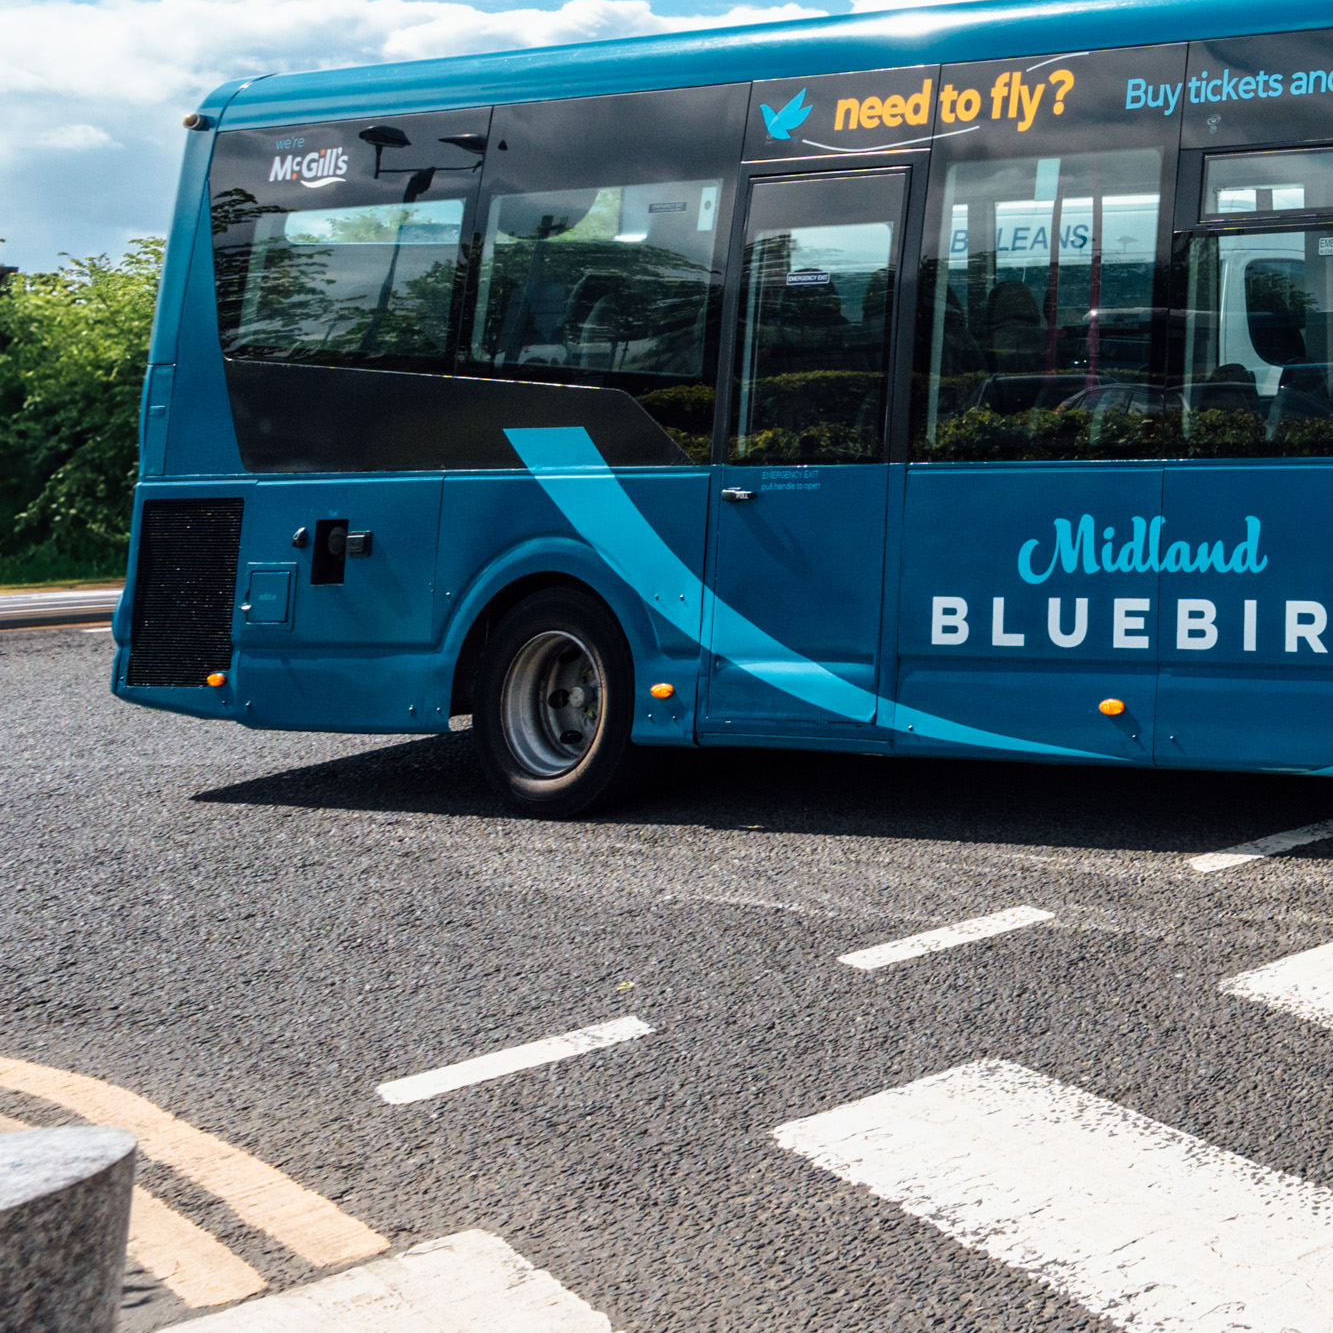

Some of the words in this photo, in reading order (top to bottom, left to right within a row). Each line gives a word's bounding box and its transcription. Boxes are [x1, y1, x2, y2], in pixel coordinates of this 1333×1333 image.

[834, 78, 933, 131] need
[940, 84, 982, 123] to
[990, 69, 1075, 132] fly?
[1125, 78, 1182, 116] Buy
[1188, 69, 1283, 104] tickets
[275, 135, 305, 150] we're
[268, 147, 349, 182] McGill's
[761, 482, 773, 492] pull
[774, 481, 795, 491] handle
[796, 482, 804, 491] to
[805, 482, 821, 492] open
[762, 470, 803, 480] EMERGENCY
[804, 469, 819, 479] EXIT
[1017, 513, 1268, 585] Midland
